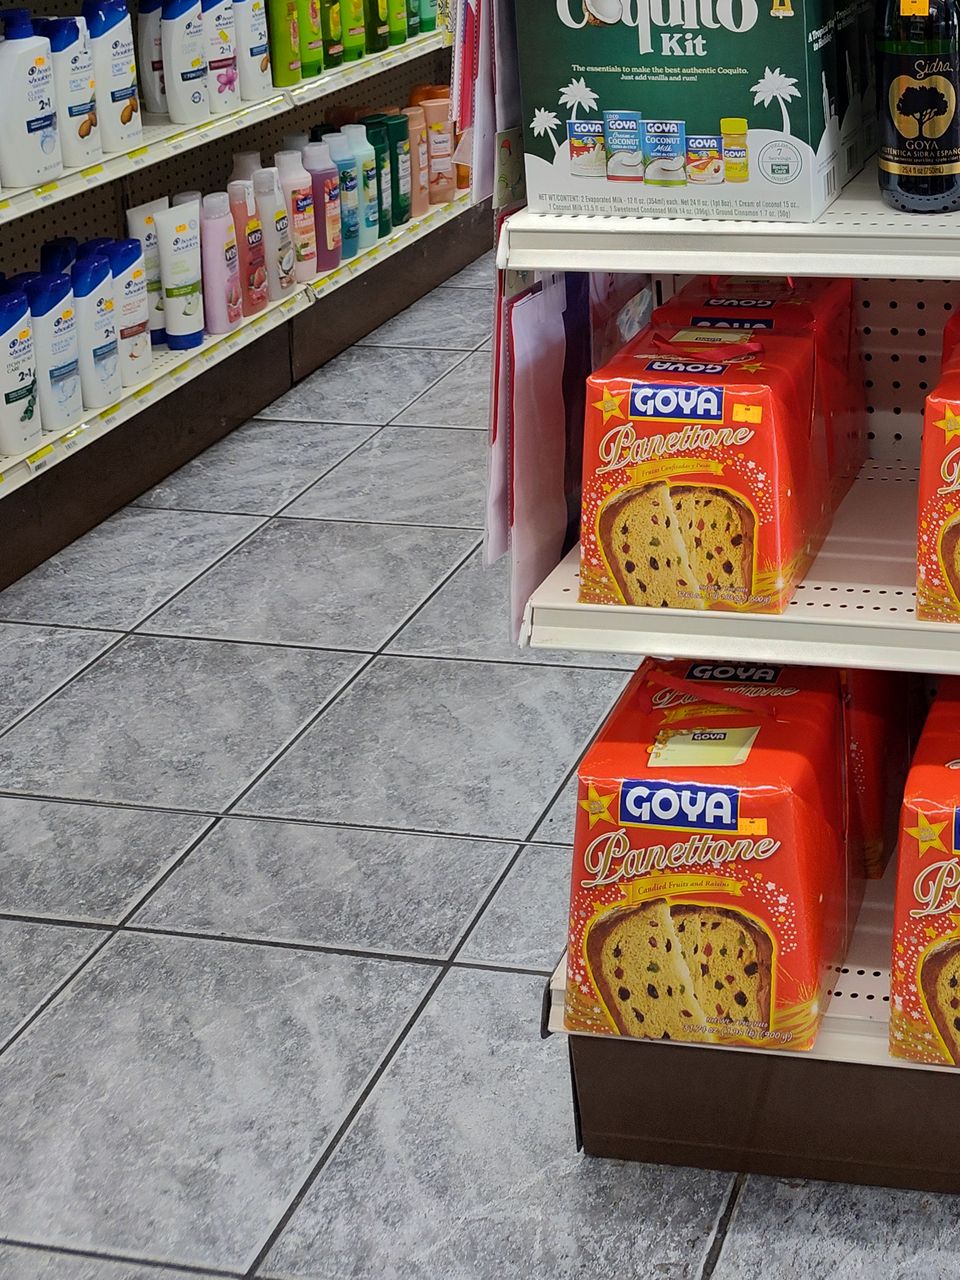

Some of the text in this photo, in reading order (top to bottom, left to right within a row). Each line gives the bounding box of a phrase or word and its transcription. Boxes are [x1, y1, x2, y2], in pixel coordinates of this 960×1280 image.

[661, 34, 708, 56] Kit
[587, 65, 621, 73] essentials
[632, 66, 653, 74] make
[665, 66, 680, 74] best
[682, 67, 716, 75] authentic
[717, 67, 749, 75] Coquito.
[914, 59, 953, 79] Sidra
[574, 123, 602, 132] GOYA
[609, 121, 636, 131] GOYA
[647, 123, 678, 132] GOYA
[608, 137, 639, 145] COCONUT
[645, 136, 680, 144] COCONUT
[688, 139, 717, 148] GOYA
[906, 140, 938, 150] GOYA
[656, 144, 673, 152] Milk
[724, 150, 745, 158] GOYA
[913, 150, 935, 158] SIDRA
[652, 362, 724, 374] GOYA
[633, 386, 722, 417] GOYA
[595, 423, 755, 475] Panettone
[692, 666, 776, 680] GOYA
[625, 785, 738, 824] GOYA
[580, 827, 782, 889] Panettone
[637, 880, 688, 897] Candied Fruits
